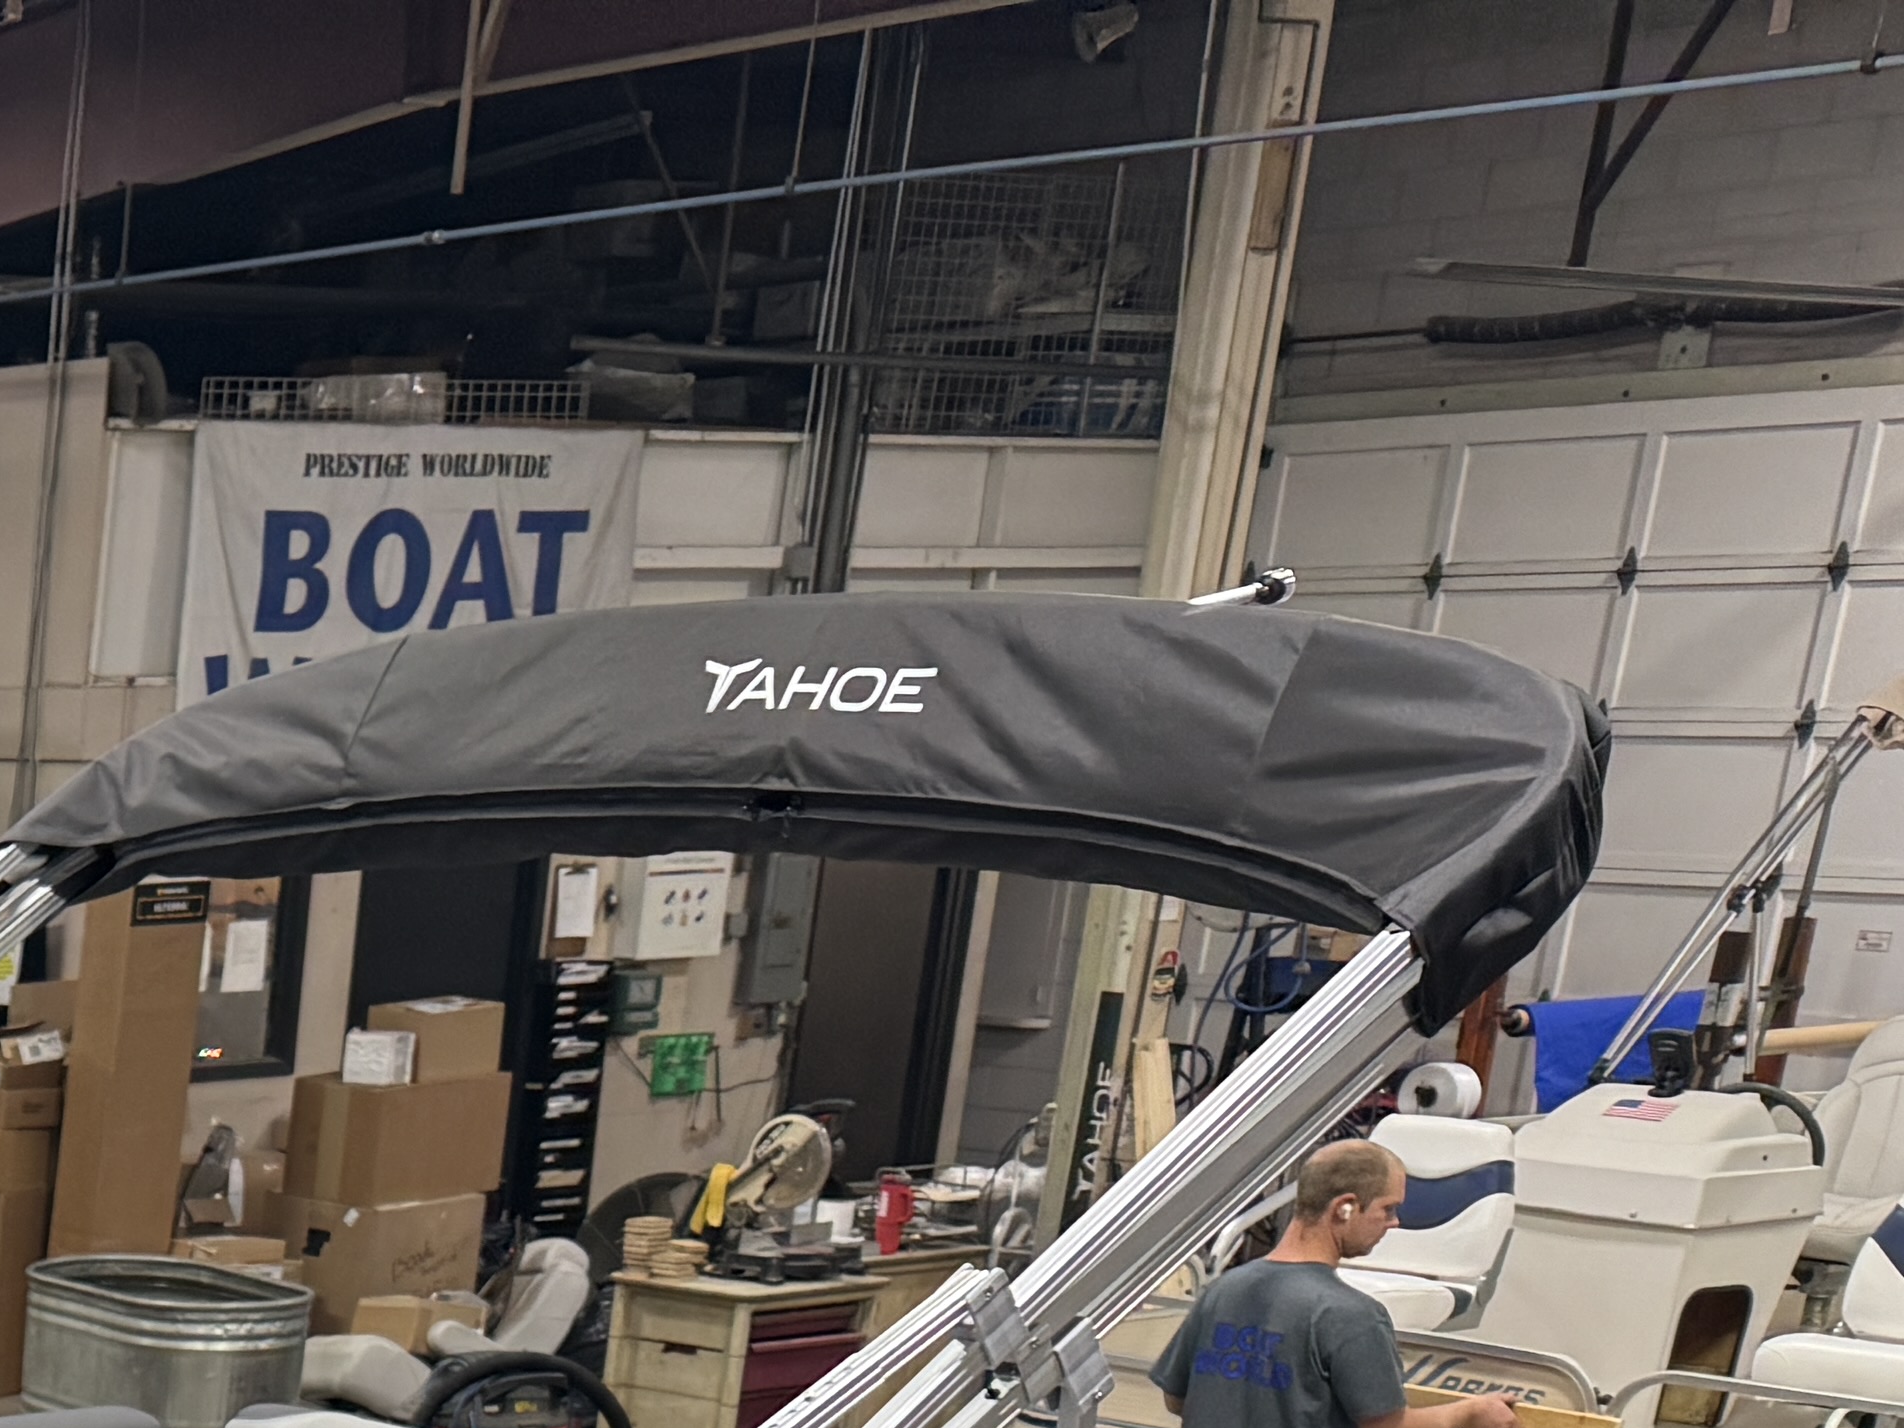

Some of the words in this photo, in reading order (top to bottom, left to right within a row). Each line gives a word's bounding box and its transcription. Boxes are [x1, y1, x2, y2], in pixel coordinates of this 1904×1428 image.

[303, 453, 409, 479] PRESTIGE
[422, 453, 552, 480] WORLDWIDE
[254, 508, 590, 633] BOAT
[705, 658, 938, 713] TAHOE
